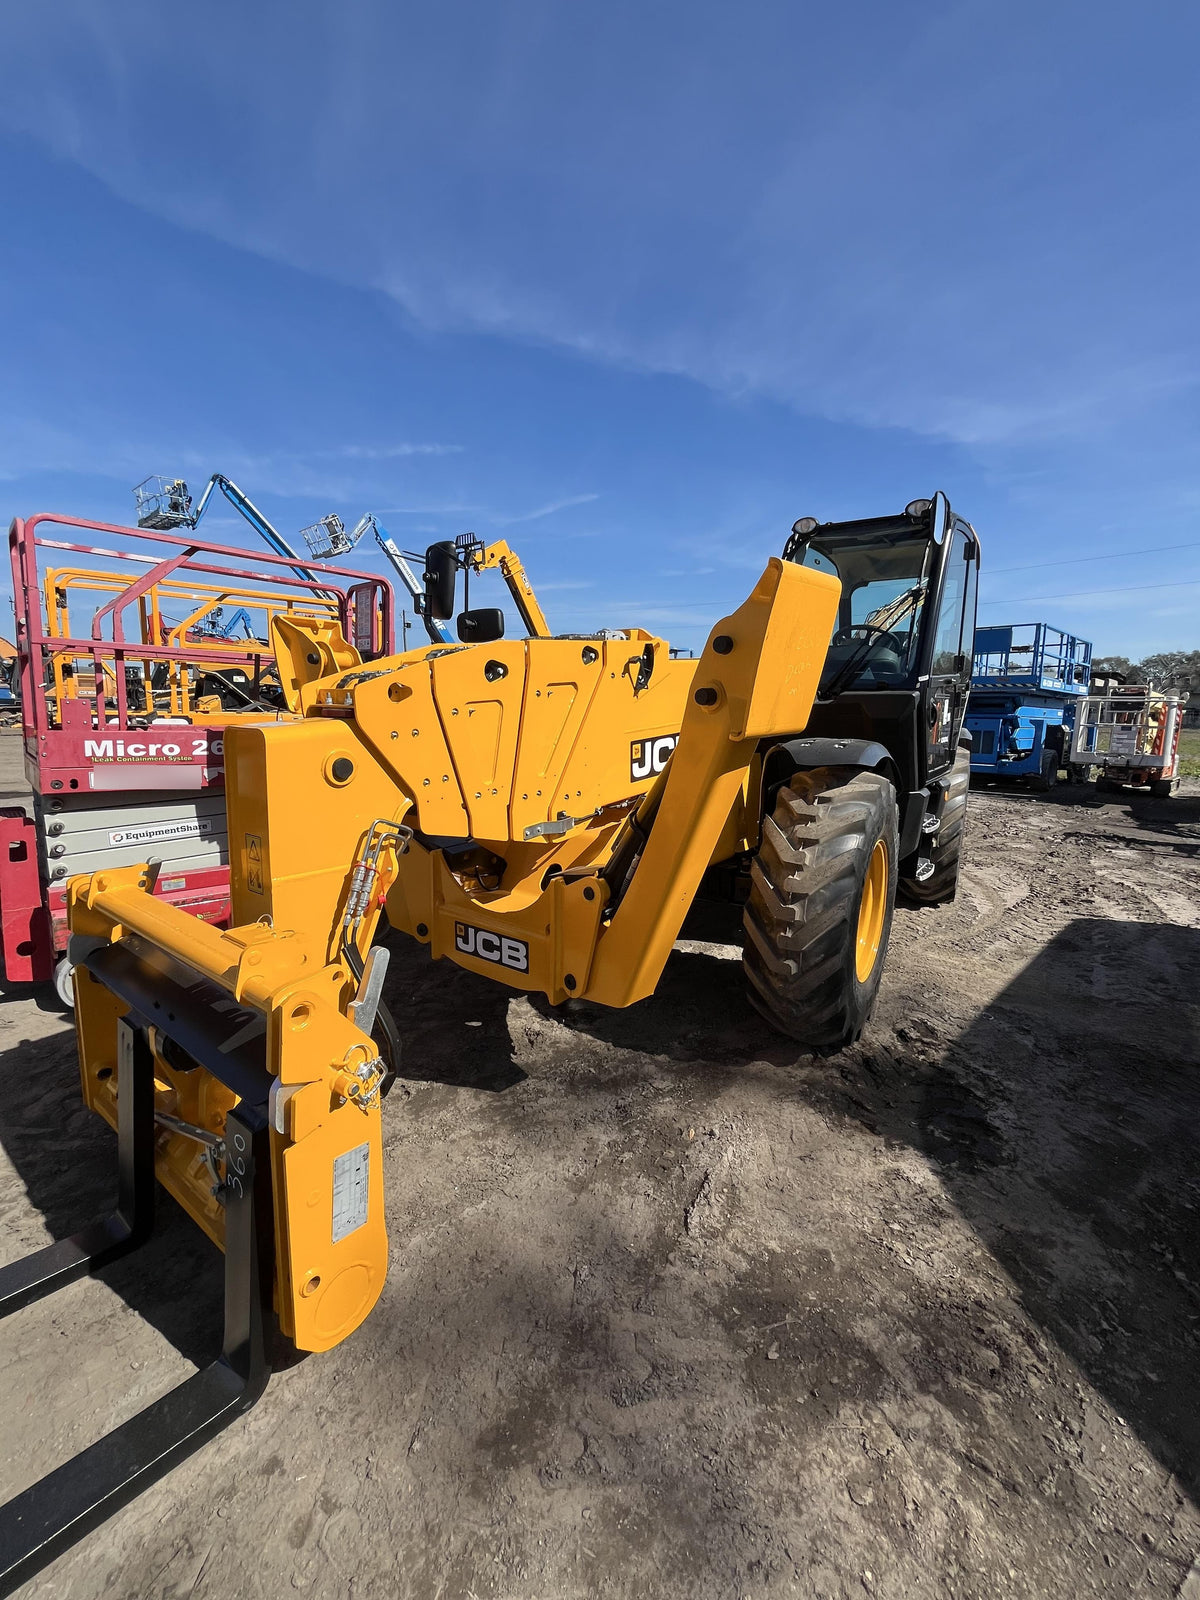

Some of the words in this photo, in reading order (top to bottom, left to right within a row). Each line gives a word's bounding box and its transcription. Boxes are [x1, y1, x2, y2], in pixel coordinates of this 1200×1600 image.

[84, 740, 181, 757] Micro
[192, 740, 224, 757] 26
[632, 735, 680, 778] JC
[125, 823, 208, 840] EquipmentShare
[456, 927, 528, 970] JCB
